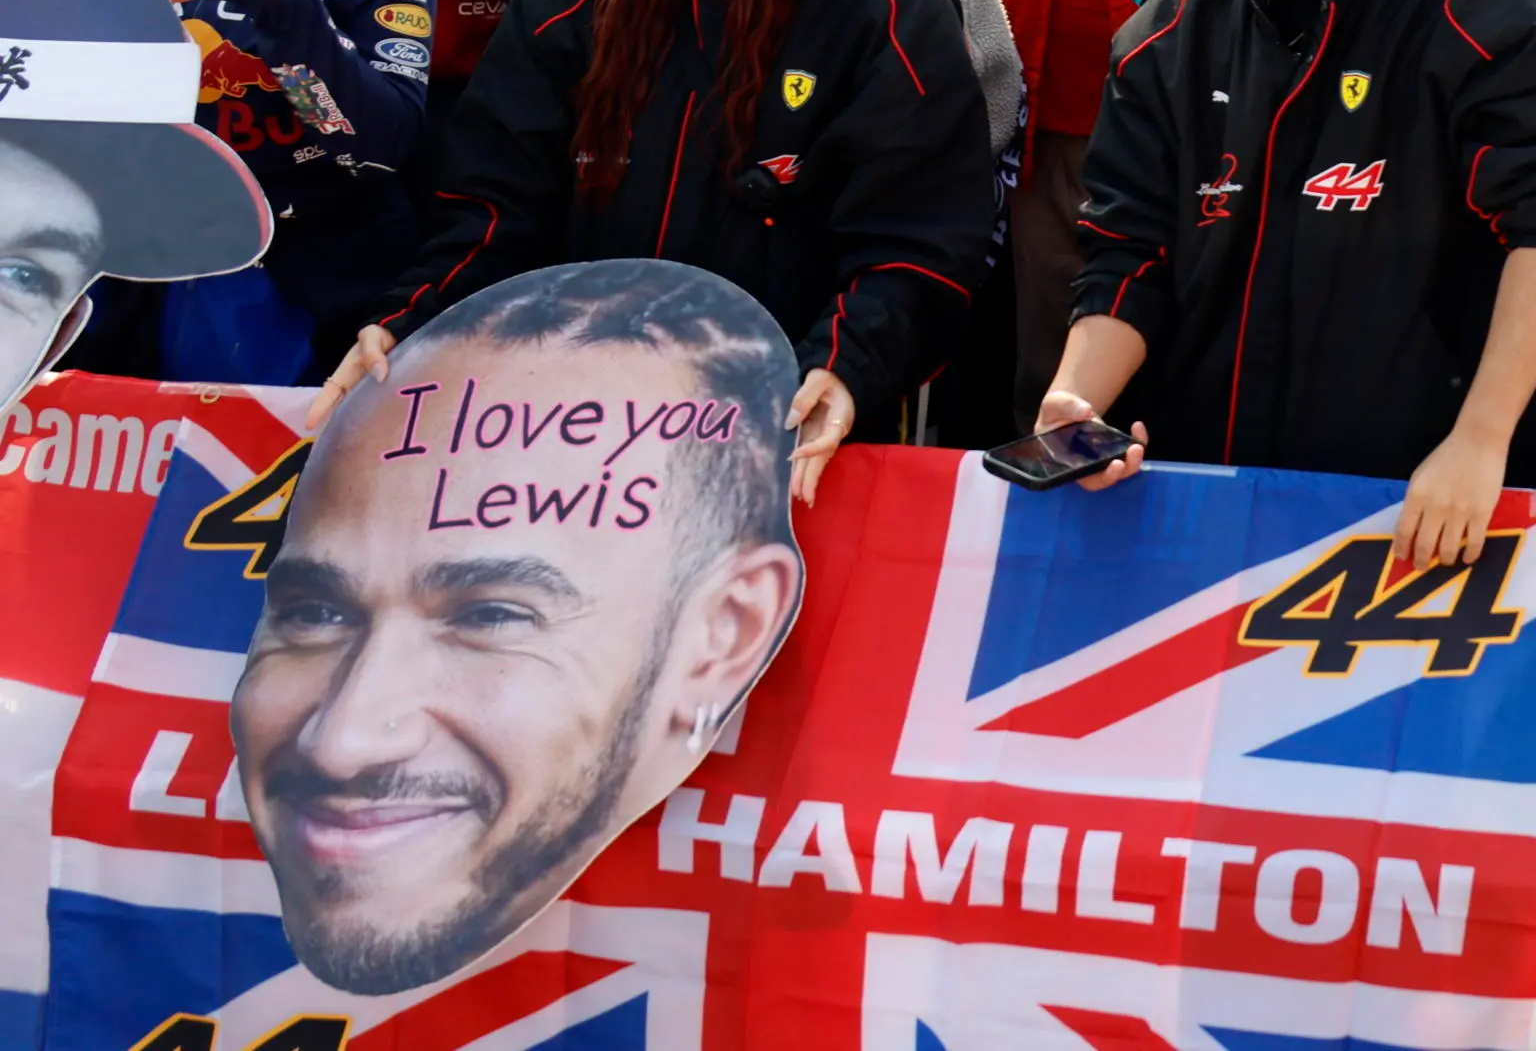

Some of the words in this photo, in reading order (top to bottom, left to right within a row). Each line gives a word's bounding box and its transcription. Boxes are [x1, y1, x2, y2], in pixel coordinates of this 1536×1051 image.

[388, 41, 425, 62] Ford
[1302, 159, 1388, 211] 44
[383, 382, 441, 462] I
[450, 377, 605, 454] love
[600, 399, 742, 468] you
[427, 467, 659, 532] Lewis
[1237, 529, 1527, 678] 44
[657, 786, 1477, 957] HAMILTON
